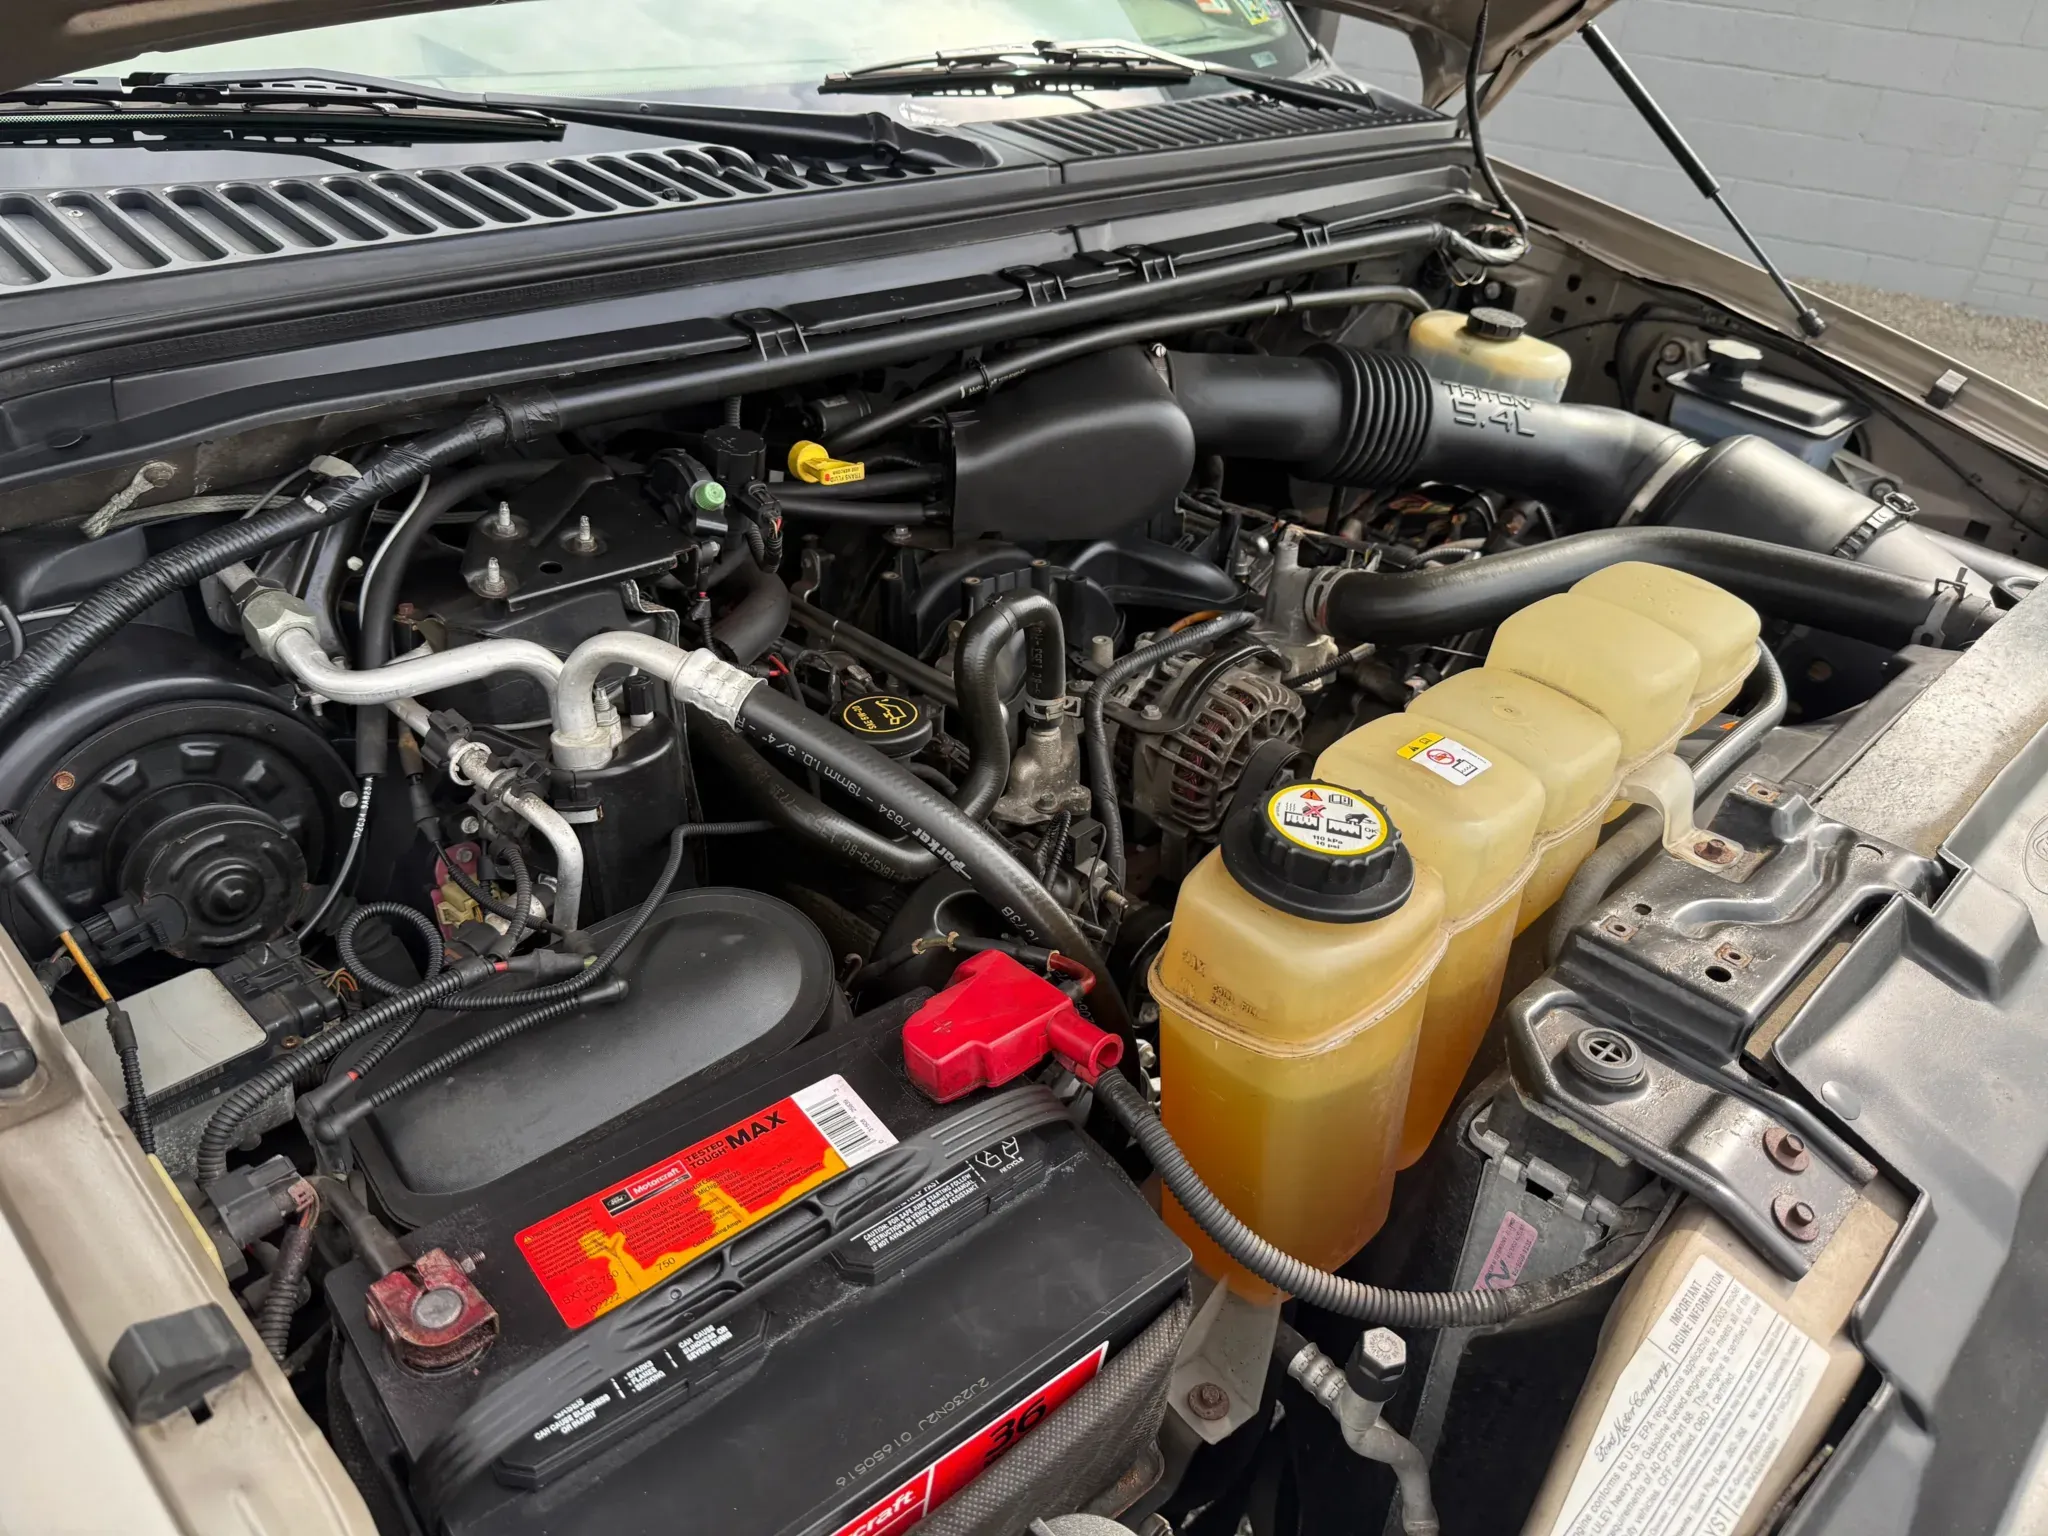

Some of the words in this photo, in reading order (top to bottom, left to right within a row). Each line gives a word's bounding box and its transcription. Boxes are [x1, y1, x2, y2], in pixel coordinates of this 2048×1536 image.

[1438, 380, 1533, 410] TRITON
[1448, 398, 1538, 437] 5.4L
[821, 764, 864, 798] 19mm
[876, 802, 911, 831] 7634
[1364, 826, 1377, 834] OK
[907, 824, 968, 873] Parker
[1327, 836, 1343, 844] kPa
[684, 1138, 724, 1164] TESTED
[724, 1108, 788, 1150] MAX
[631, 1165, 681, 1195] Motorcraft
[616, 1203, 660, 1230] Manufactured
[658, 1198, 669, 1208] for
[668, 1190, 685, 1202] Ford
[682, 1180, 703, 1195] Motor
[701, 1166, 731, 1186] Company
[623, 1215, 652, 1234] American
[697, 1178, 725, 1197] Michigan
[887, 1214, 901, 1226] FOR
[898, 1206, 914, 1220] SAFE
[911, 1198, 928, 1212] JUMP
[925, 1183, 952, 1203] STARTING
[949, 1171, 972, 1188] FOLLOW
[691, 1238, 705, 1248] Cold
[703, 1226, 728, 1242] Cranking
[725, 1218, 742, 1230] Amps
[866, 1219, 907, 1247] INSTRUCTIONS
[904, 1215, 913, 1224] IN
[909, 1202, 934, 1221] VEHICLE
[876, 1236, 890, 1248] NOT
[887, 1220, 917, 1242] AVAILABLE
[914, 1212, 930, 1225] SEEK
[927, 1199, 951, 1217] SERVICE
[656, 1255, 676, 1271] 750
[583, 1291, 622, 1316] 102222
[1667, 1278, 1704, 1327] IMPORTANT
[1667, 1320, 1694, 1355] ENGINE
[1685, 1269, 1726, 1324] INFORMATION
[1732, 1303, 1744, 1315] of
[1737, 1291, 1752, 1306] the
[1713, 1322, 1734, 1347] meets
[1726, 1311, 1739, 1325] all
[677, 1335, 693, 1349] CAN
[692, 1323, 715, 1341] CAUSE
[681, 1330, 717, 1356] BLINDNESS
[685, 1341, 712, 1362] SEVERE
[709, 1329, 733, 1348] BURNS
[1703, 1344, 1719, 1363] and
[1588, 1470, 1621, 1514] conforms
[1616, 1460, 1628, 1472] to
[1624, 1440, 1642, 1461] U.S.
[1637, 1419, 1656, 1440] EPA
[1650, 1374, 1687, 1421] regulations
[1679, 1334, 1713, 1377] applicable
[1704, 1324, 1717, 1337] to
[1722, 1283, 1742, 1308] model
[1640, 1472, 1653, 1485] of
[1647, 1460, 1661, 1475] 40
[1656, 1441, 1674, 1462] CFR
[1669, 1422, 1686, 1442] Part
[1691, 1384, 1711, 1407] This
[1705, 1362, 1728, 1388] engine
[1724, 1324, 1749, 1355] certified
[1663, 1392, 1689, 1423] fueled
[533, 1426, 552, 1442] CAN
[549, 1413, 575, 1433] CAUSE
[571, 1392, 612, 1419] BLINDNESS
[560, 1424, 572, 1435] OR
[570, 1409, 597, 1429] INJURY
[986, 1399, 1047, 1448] 36
[1589, 1431, 1618, 1464] Ford
[1606, 1402, 1640, 1442] Motor
[1641, 1421, 1671, 1460] Gasoline
[1655, 1464, 1675, 1488] CFF
[1691, 1408, 1712, 1432] OBD
[831, 1429, 915, 1488] 01650516
[1609, 1460, 1647, 1509] heavy-duty
[1591, 1506, 1614, 1534] ULEV
